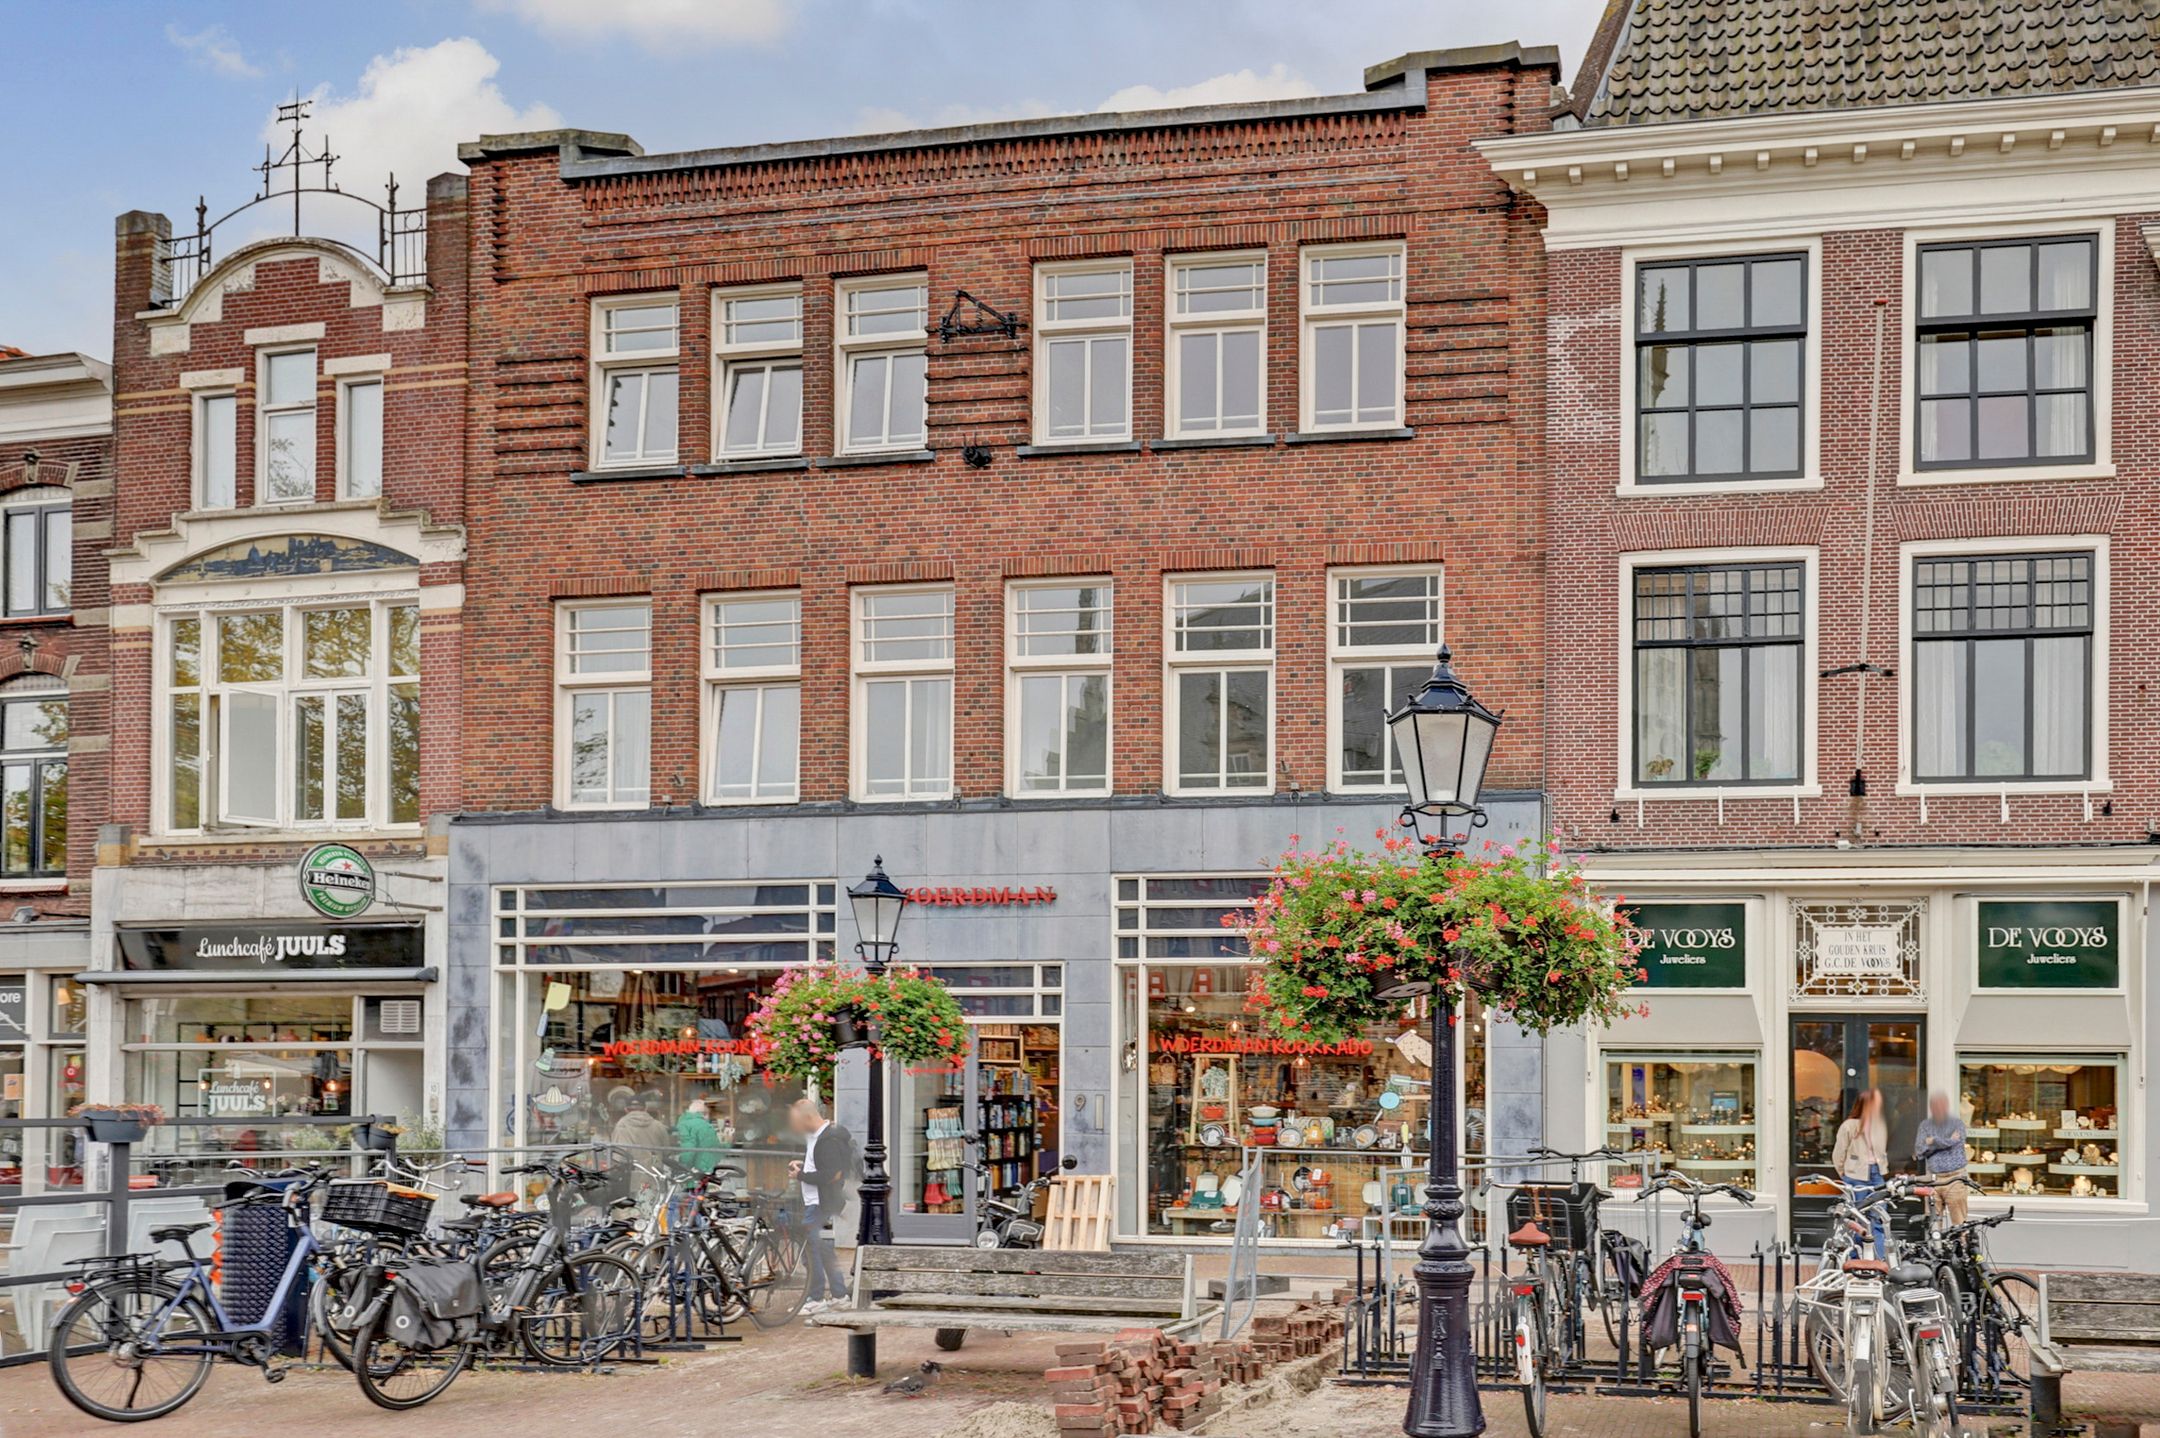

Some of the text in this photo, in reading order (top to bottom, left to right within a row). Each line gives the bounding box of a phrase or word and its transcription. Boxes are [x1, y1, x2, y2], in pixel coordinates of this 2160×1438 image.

[312, 872, 371, 889] Heineken
[1625, 927, 1736, 949] DE VOOYS
[1844, 931, 1872, 942] IN HET
[1987, 926, 2108, 948] DE VOOYS
[196, 934, 346, 964] Lunchcafé JUULS
[1828, 944, 1887, 956] GOUDEN KRUIS
[1659, 953, 1707, 965] Juweliers
[1861, 957, 1892, 969] VOOYS
[2026, 953, 2077, 964] Juweliers
[602, 1038, 700, 1057] WOERDMAN
[1160, 1037, 1270, 1054] WOERDMAN
[209, 1080, 260, 1100] Lunchcafé
[207, 1094, 267, 1116] JUULS
[1073, 1094, 1087, 1112] 9
